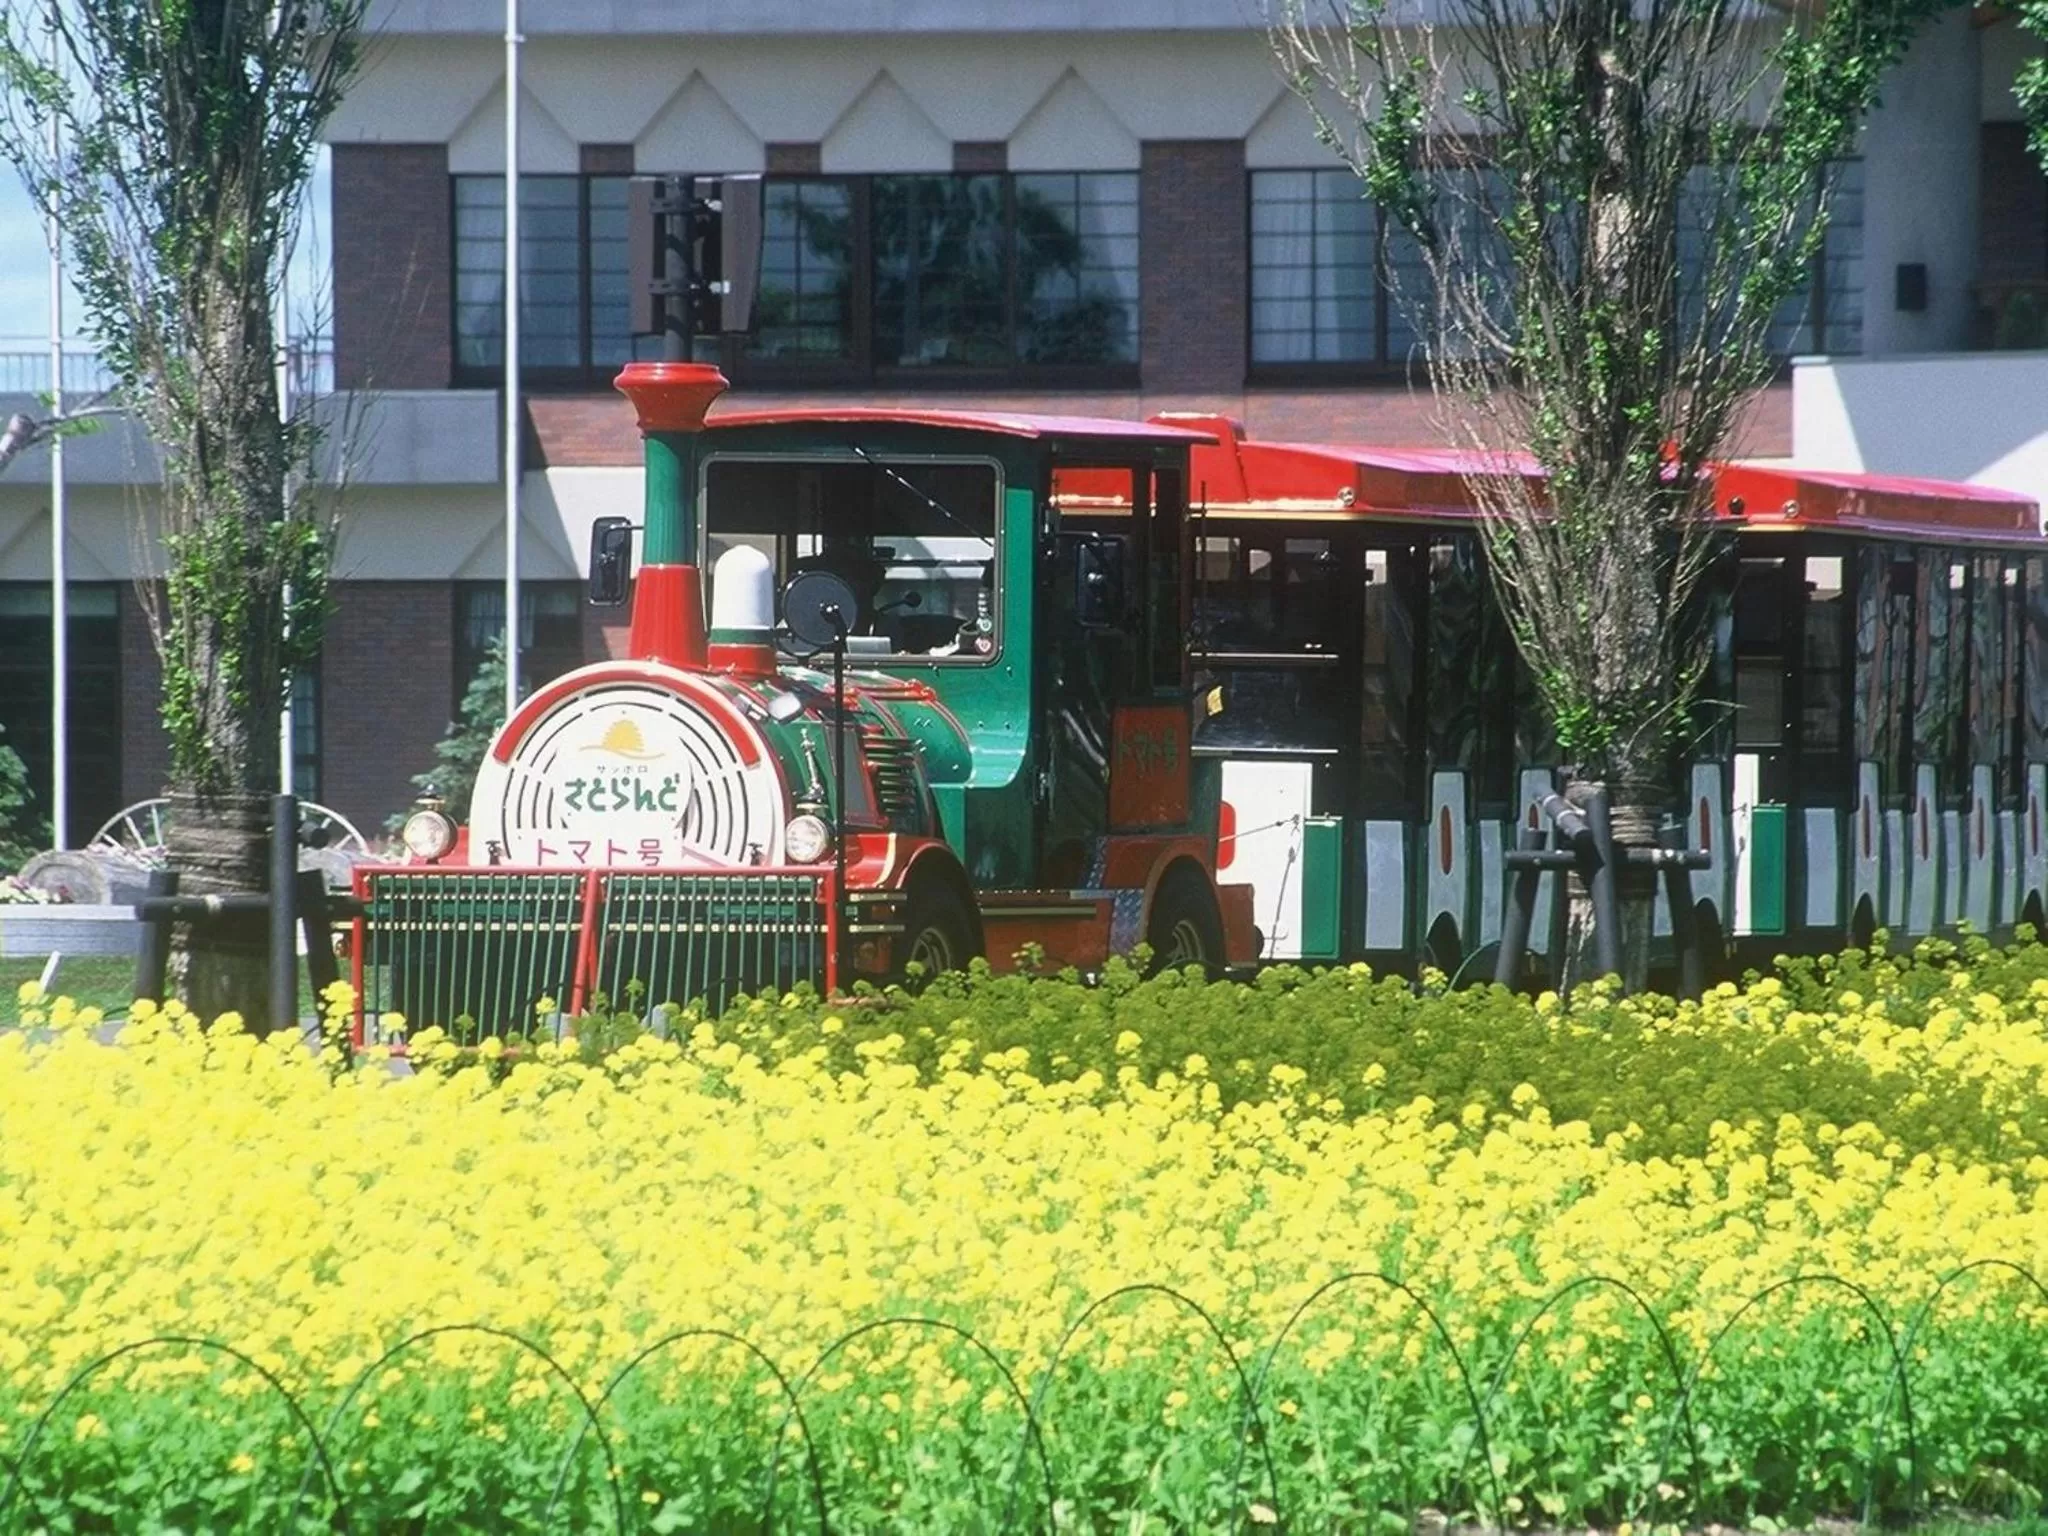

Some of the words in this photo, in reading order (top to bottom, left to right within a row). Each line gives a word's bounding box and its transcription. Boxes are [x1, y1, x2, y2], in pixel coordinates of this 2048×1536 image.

[565, 774, 680, 811] さとらんど
[538, 839, 663, 866] トマト号
